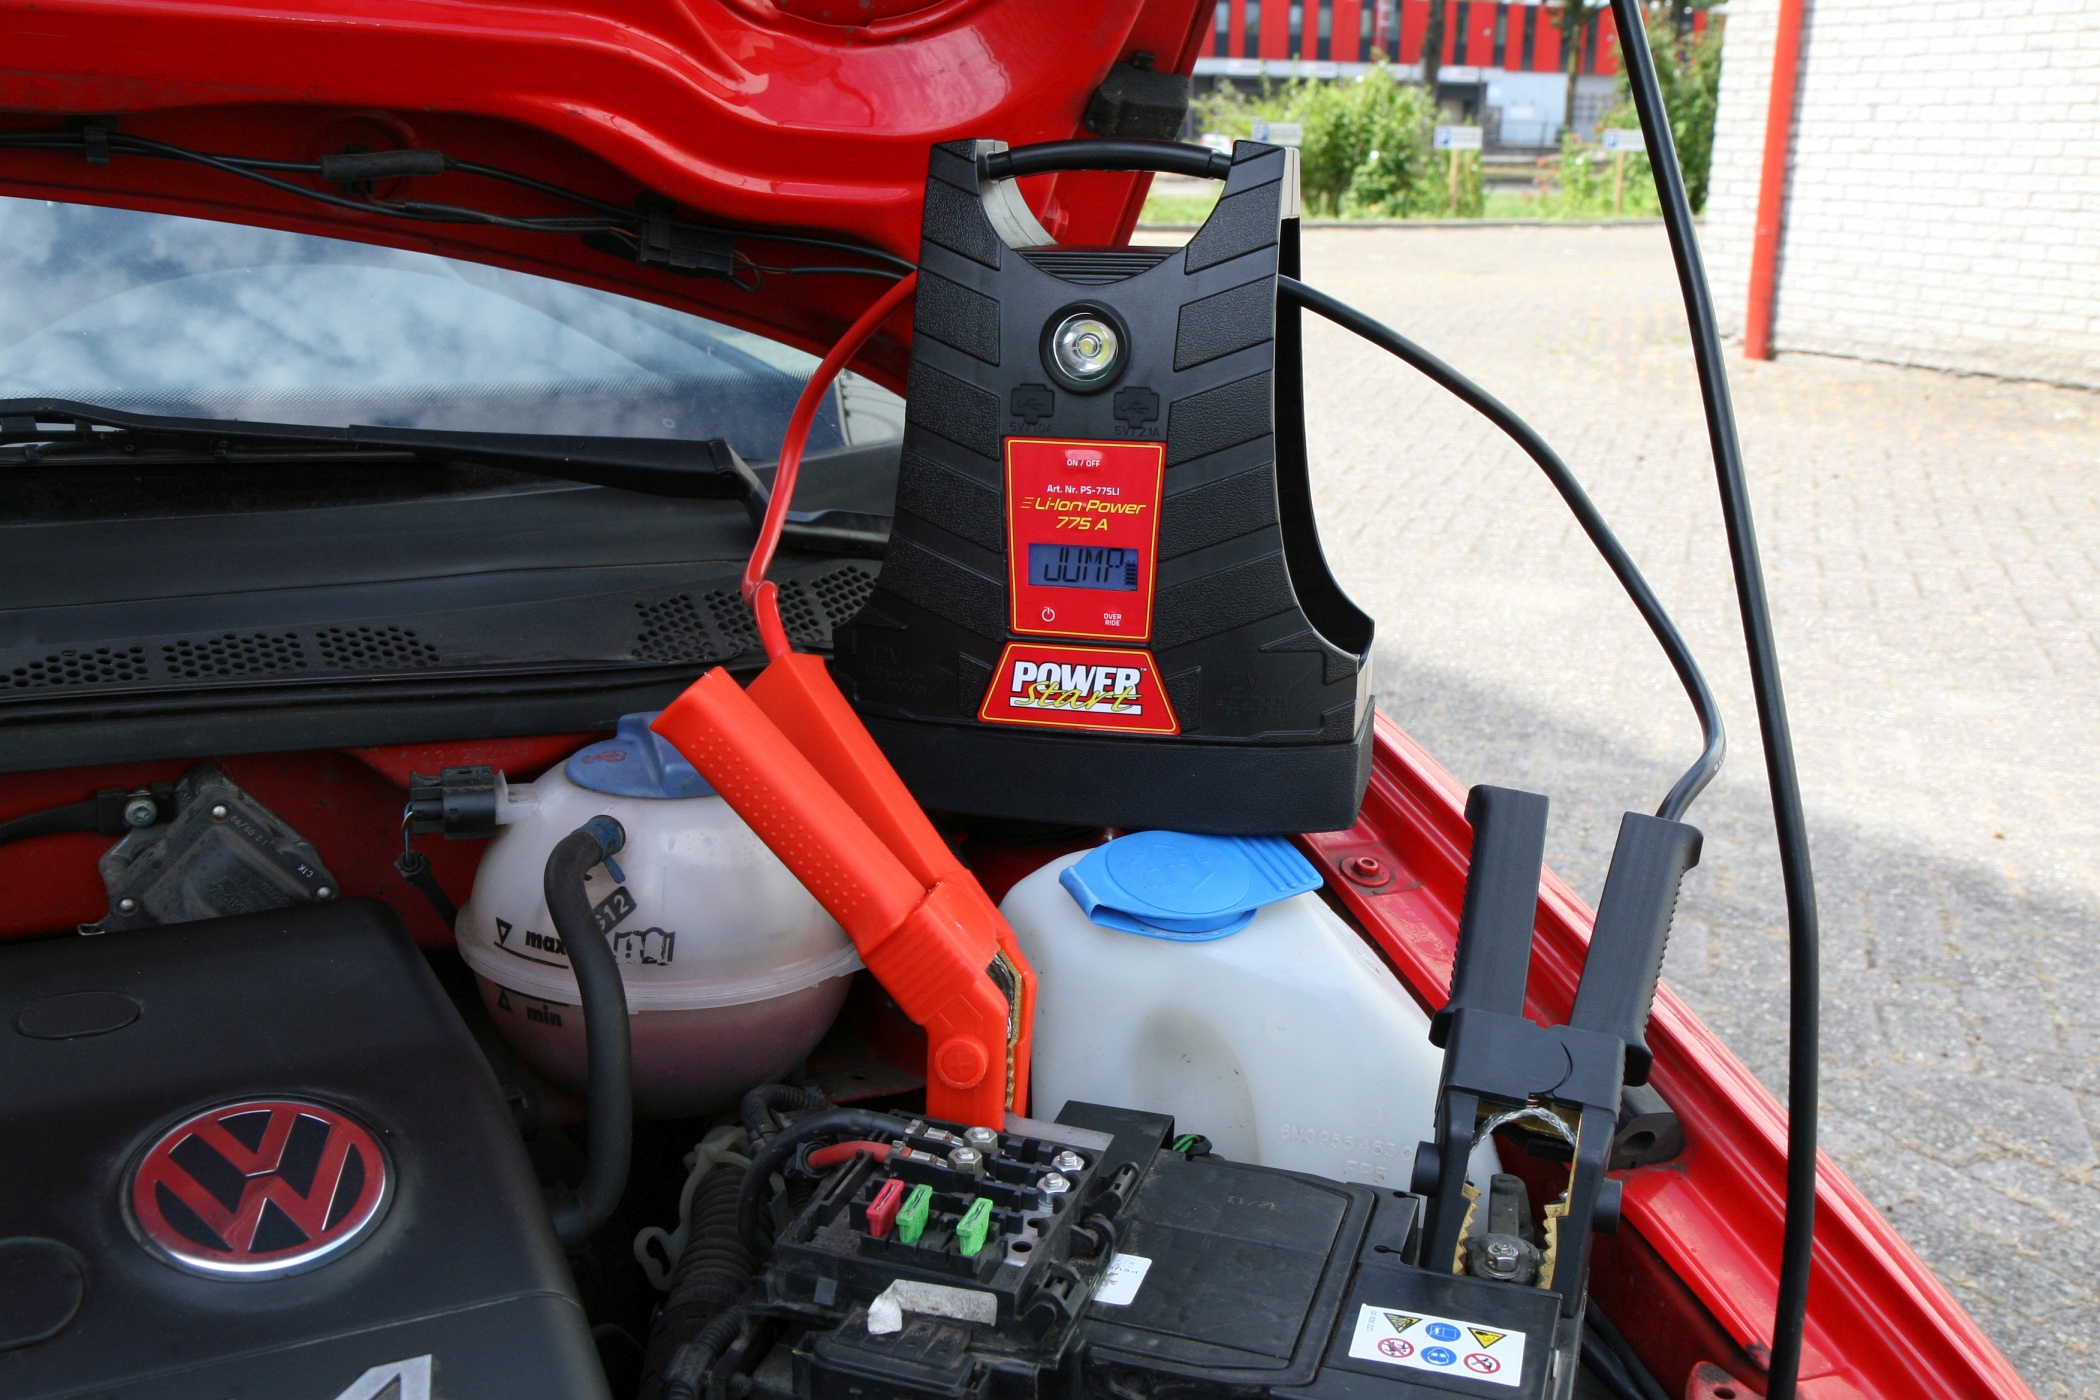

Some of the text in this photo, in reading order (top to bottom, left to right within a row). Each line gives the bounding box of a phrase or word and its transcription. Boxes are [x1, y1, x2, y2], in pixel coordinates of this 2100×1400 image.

[1066, 458, 1078, 467] ON
[1085, 459, 1101, 468] OFF
[1046, 484, 1120, 496] Art. Nr. PS-775LI
[1034, 497, 1147, 515] Li-Ion Power
[1056, 516, 1109, 531] 775 A
[1043, 547, 1125, 583] JUMP
[1103, 612, 1122, 620] OVER
[1104, 619, 1121, 627] RIDE
[1011, 660, 1141, 700] POWER
[1014, 680, 1142, 712] Start
[525, 930, 567, 956] max
[526, 1004, 562, 1028] min
